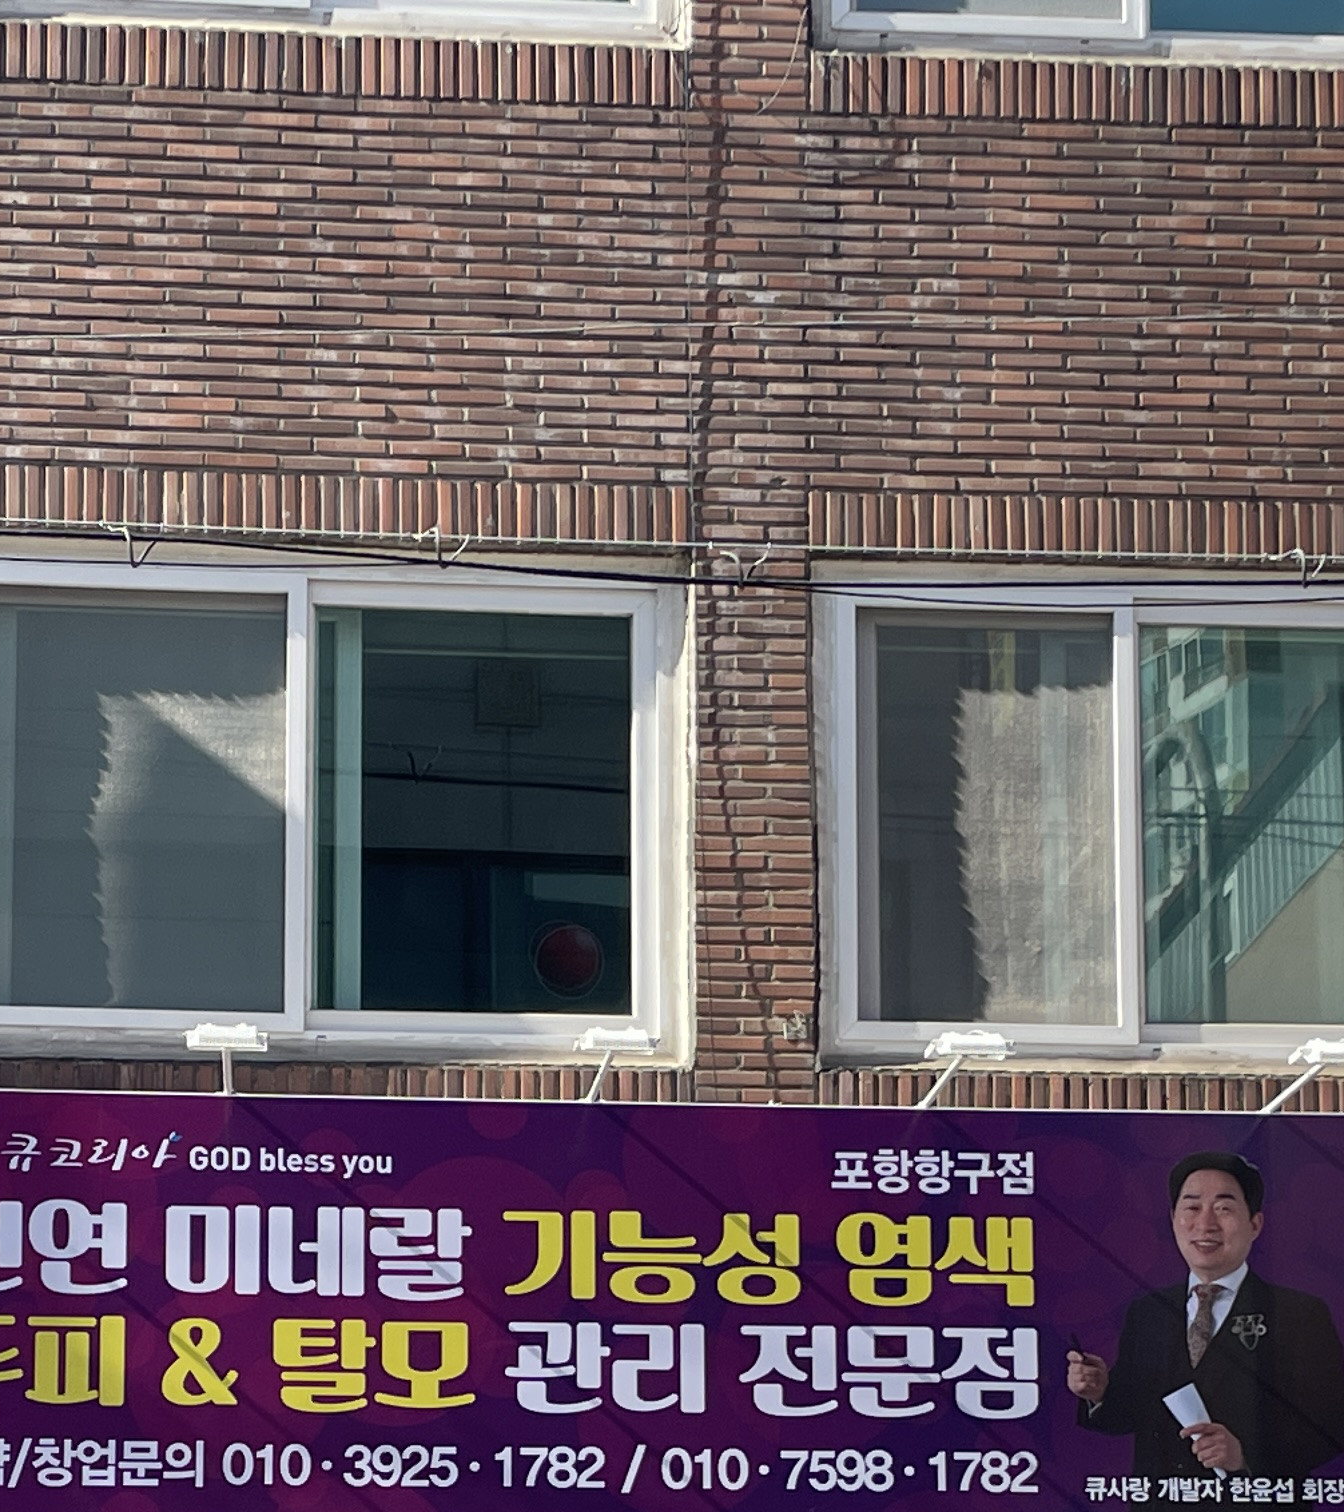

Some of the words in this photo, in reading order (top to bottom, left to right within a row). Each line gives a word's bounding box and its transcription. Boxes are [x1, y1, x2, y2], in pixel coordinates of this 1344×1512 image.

[189, 1146, 251, 1171] GOD
[259, 1146, 336, 1173] bless
[342, 1154, 392, 1178] you
[831, 1149, 1036, 1196] 포항항구점
[165, 1205, 472, 1302] 미네랄
[502, 1209, 802, 1305] 기능성
[835, 1212, 1036, 1308] 염색
[161, 1318, 236, 1407] &
[272, 1320, 476, 1414] 탈모
[504, 1321, 706, 1415] 관리
[739, 1323, 1039, 1420] 전문점
[1084, 1476, 1151, 1502] 큐사랑
[1157, 1477, 1224, 1503] 개발자
[1228, 1477, 1296, 1503] 한윤섭
